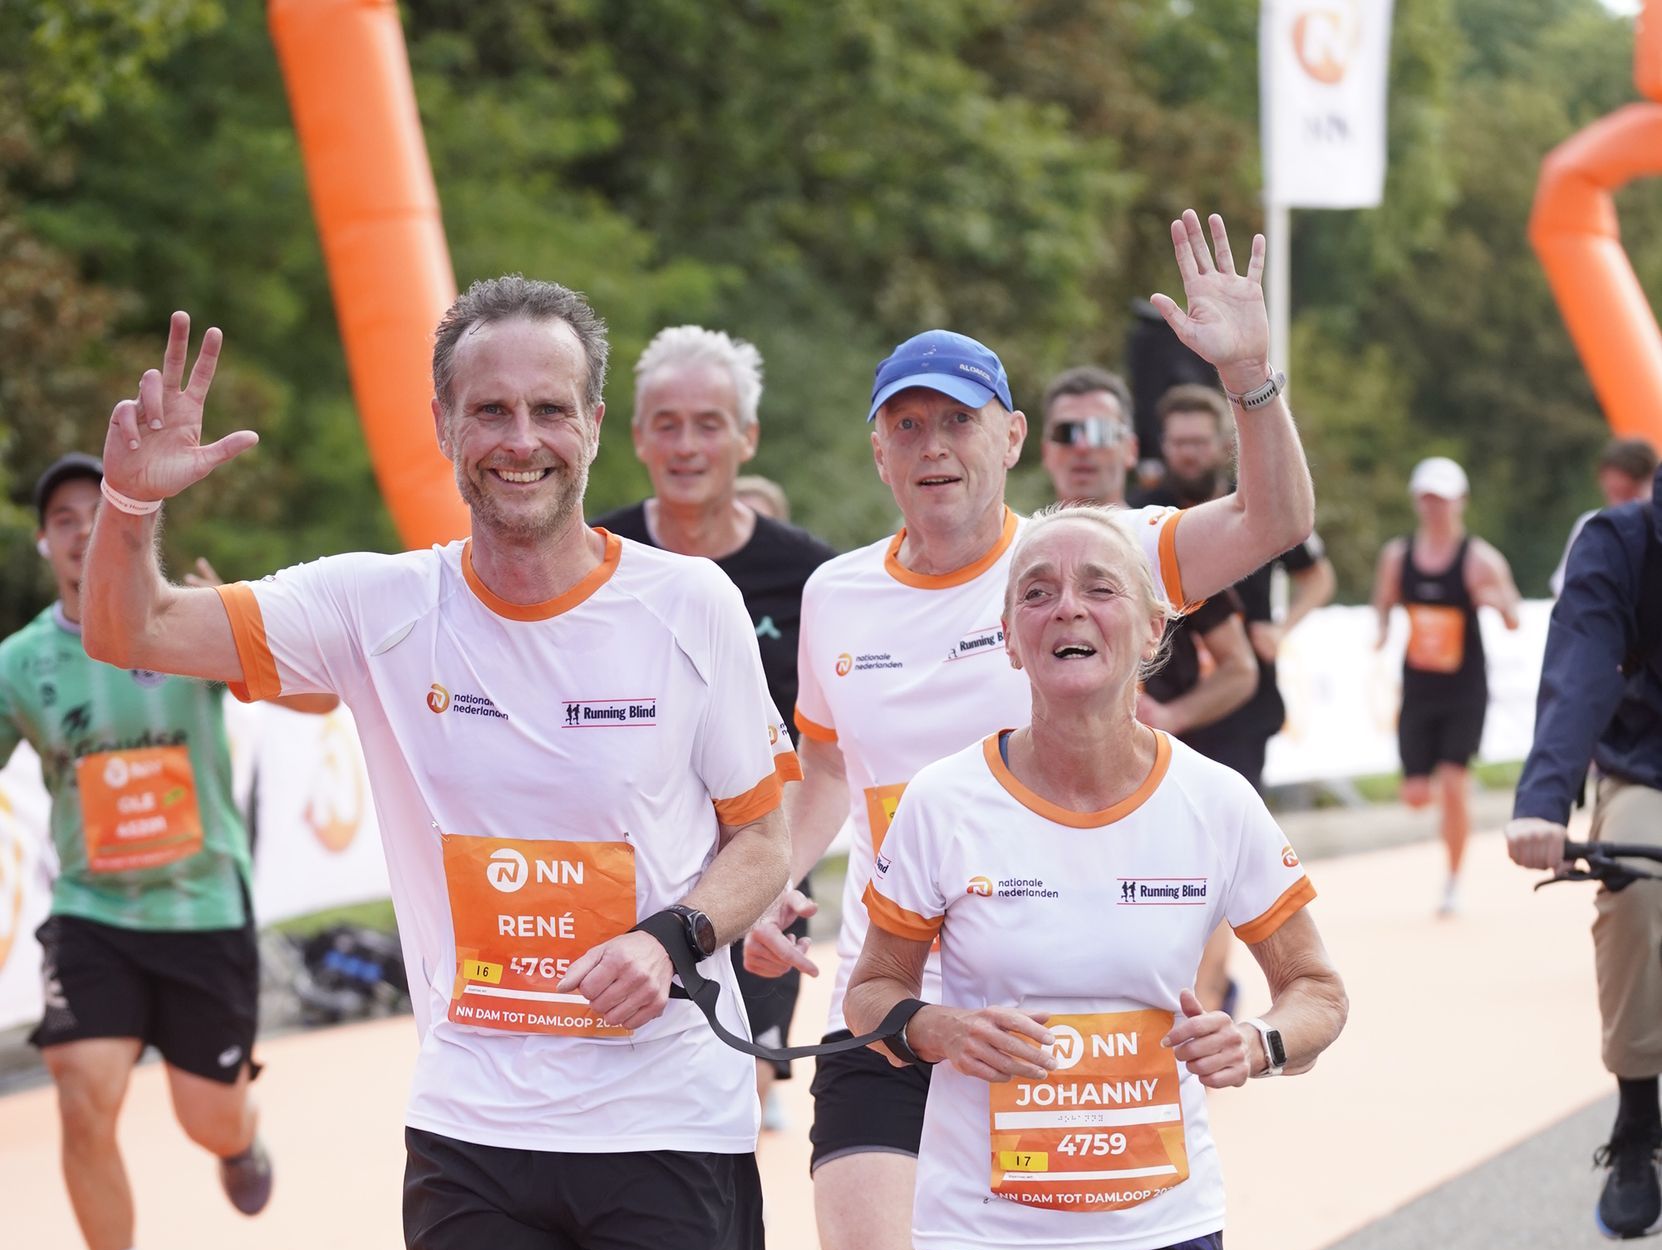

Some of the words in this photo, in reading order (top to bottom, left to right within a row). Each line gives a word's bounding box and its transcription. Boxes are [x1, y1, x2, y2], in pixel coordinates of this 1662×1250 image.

[960, 635, 996, 651] Running
[855, 653, 891, 661] nationale
[854, 661, 903, 670] nederlanden
[583, 706, 627, 720] Running
[629, 704, 656, 718] Blind
[535, 859, 584, 884] NN
[998, 878, 1043, 887] nationale
[998, 888, 1059, 898] nederlanden
[1140, 884, 1180, 899] Running
[1182, 884, 1206, 897] Blind
[498, 912, 575, 939] RENÉ
[455, 1005, 474, 1017] NN
[475, 1008, 500, 1020] DAM
[502, 1013, 525, 1024] TOT
[527, 1014, 593, 1028] DAMLOOP
[1091, 1032, 1138, 1058] NN
[1015, 1078, 1158, 1106] JOHANNY
[1056, 1132, 1127, 1156] 4759
[1022, 1193, 1053, 1204] DAM
[1056, 1193, 1083, 1204] TOT
[1085, 1189, 1151, 1204] DAMLOOP
